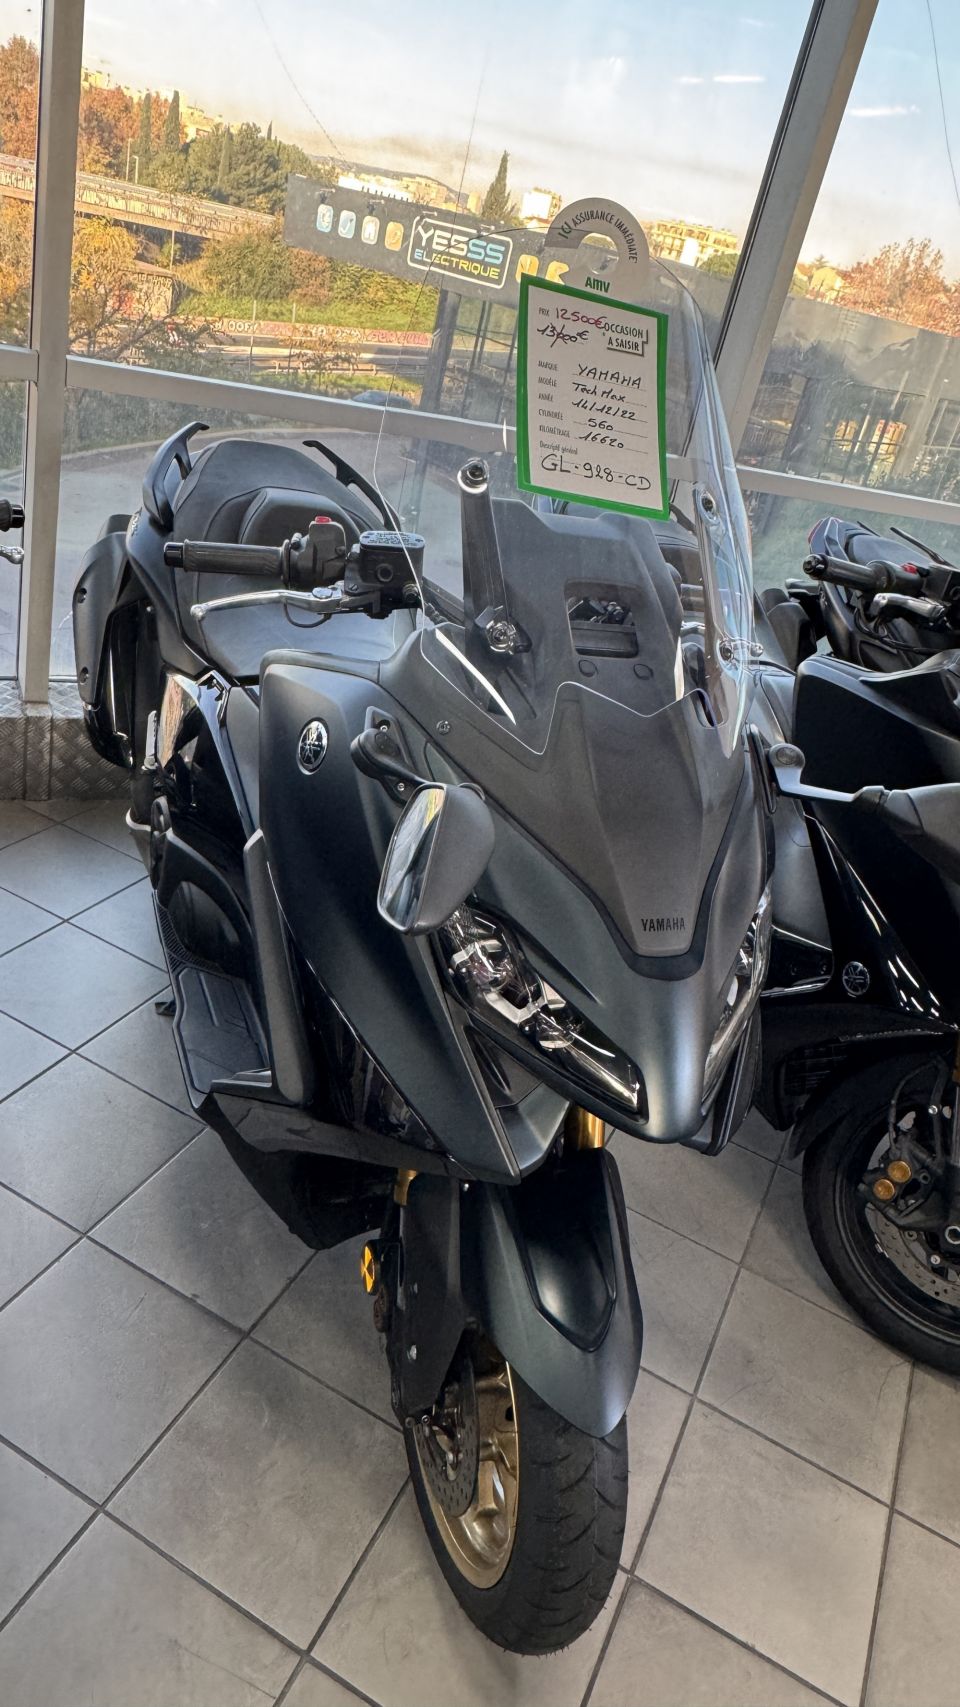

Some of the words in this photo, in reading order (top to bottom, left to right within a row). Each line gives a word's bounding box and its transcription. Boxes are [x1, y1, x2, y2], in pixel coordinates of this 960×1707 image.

[418, 225, 505, 265] YESSS
[558, 221, 572, 239] ICI
[572, 210, 615, 227] ASSURANCE
[614, 219, 638, 263] IMMÉDIATE
[414, 248, 500, 279] ELECTRIQUE
[556, 307, 608, 330] 12500€
[604, 322, 644, 339] OCCASION
[615, 338, 640, 352] SAISIR
[578, 363, 642, 389] YAMAHA
[571, 398, 636, 421] 14/12/22
[587, 418, 615, 431] 560
[578, 431, 625, 449] 16620
[640, 917, 686, 932] YAMAHA
